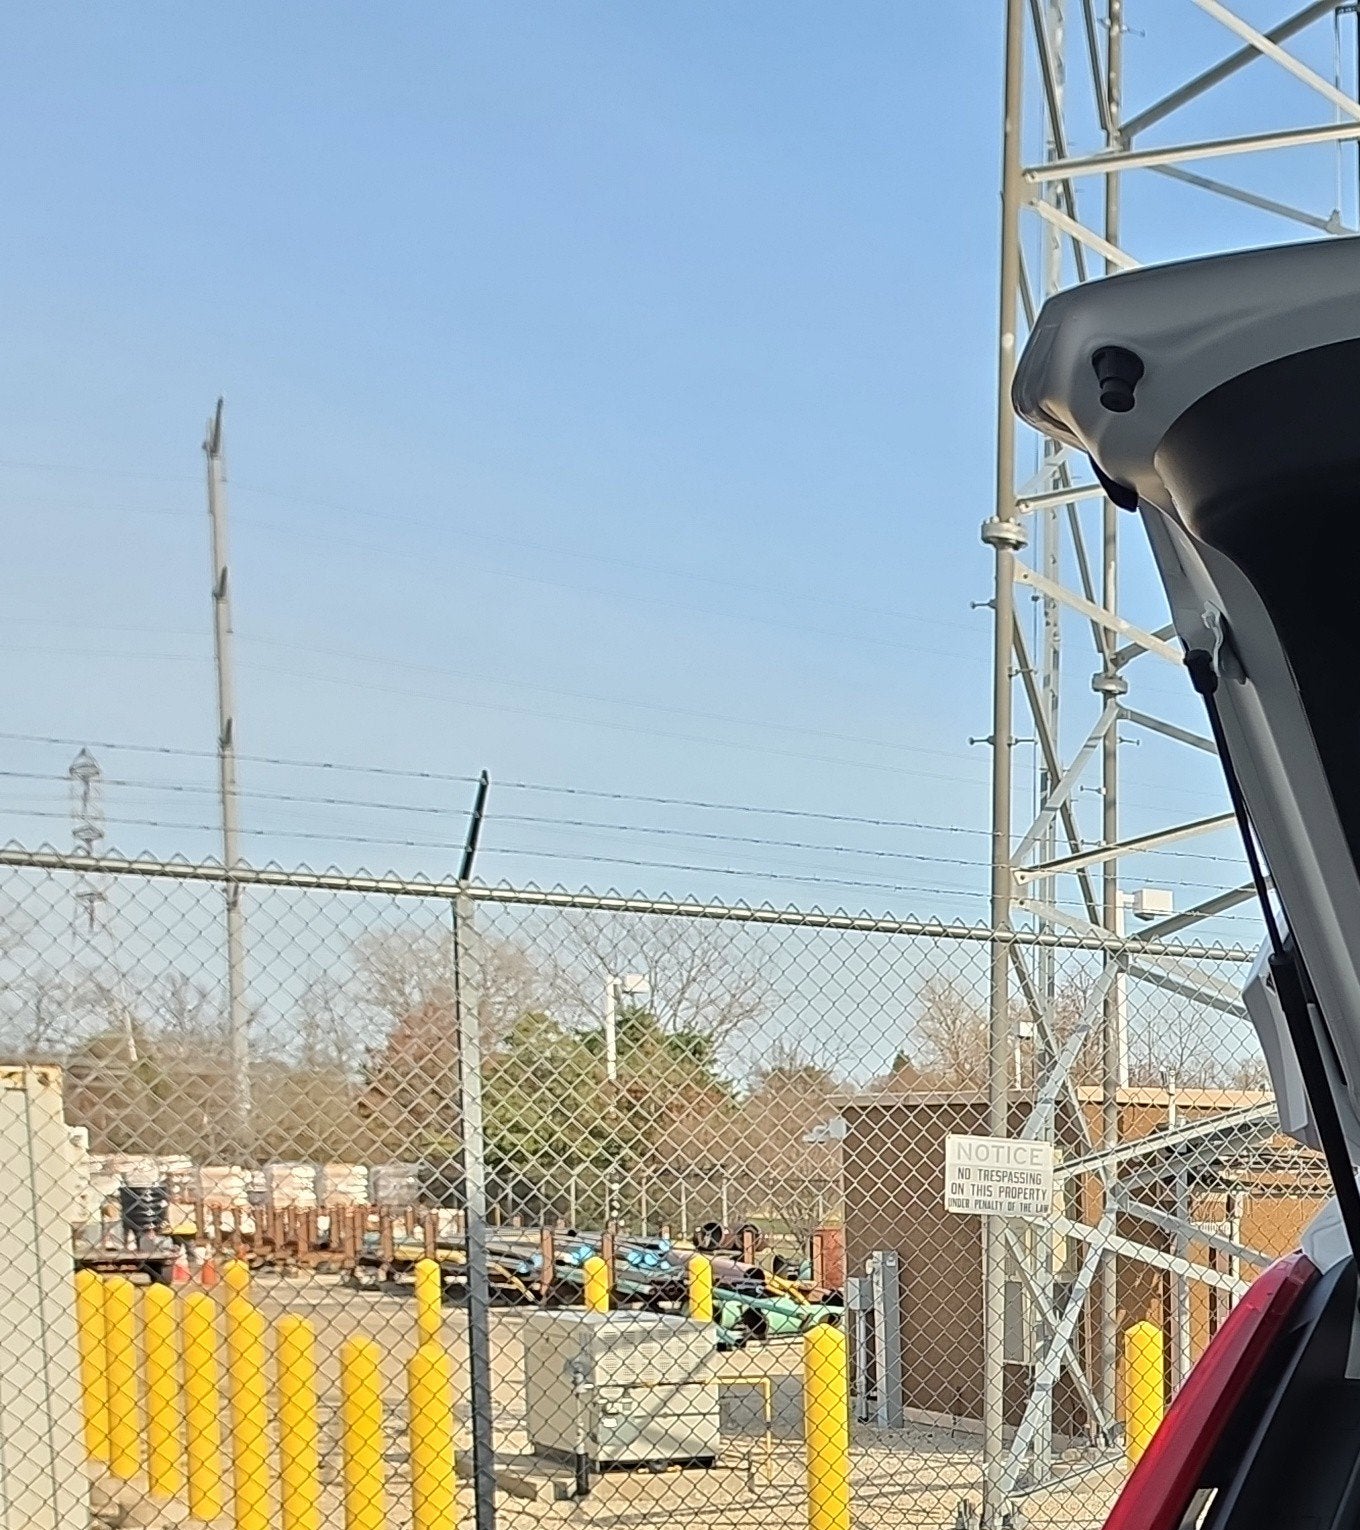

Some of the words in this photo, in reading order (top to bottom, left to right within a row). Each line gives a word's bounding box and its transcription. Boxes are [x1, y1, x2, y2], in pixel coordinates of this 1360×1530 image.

[957, 1142, 1043, 1166] NOTICE
[957, 1167, 971, 1180] NO
[978, 1168, 1042, 1185] TRESPASSING
[951, 1182, 965, 1195] ON
[970, 1183, 993, 1197] THIS
[999, 1185, 1047, 1201] PROPERTY
[948, 1197, 970, 1208] UNDER
[974, 1199, 1003, 1211] PENALTY
[1007, 1202, 1015, 1212] OF
[1020, 1202, 1031, 1213] THE
[1036, 1203, 1049, 1213] LAW
